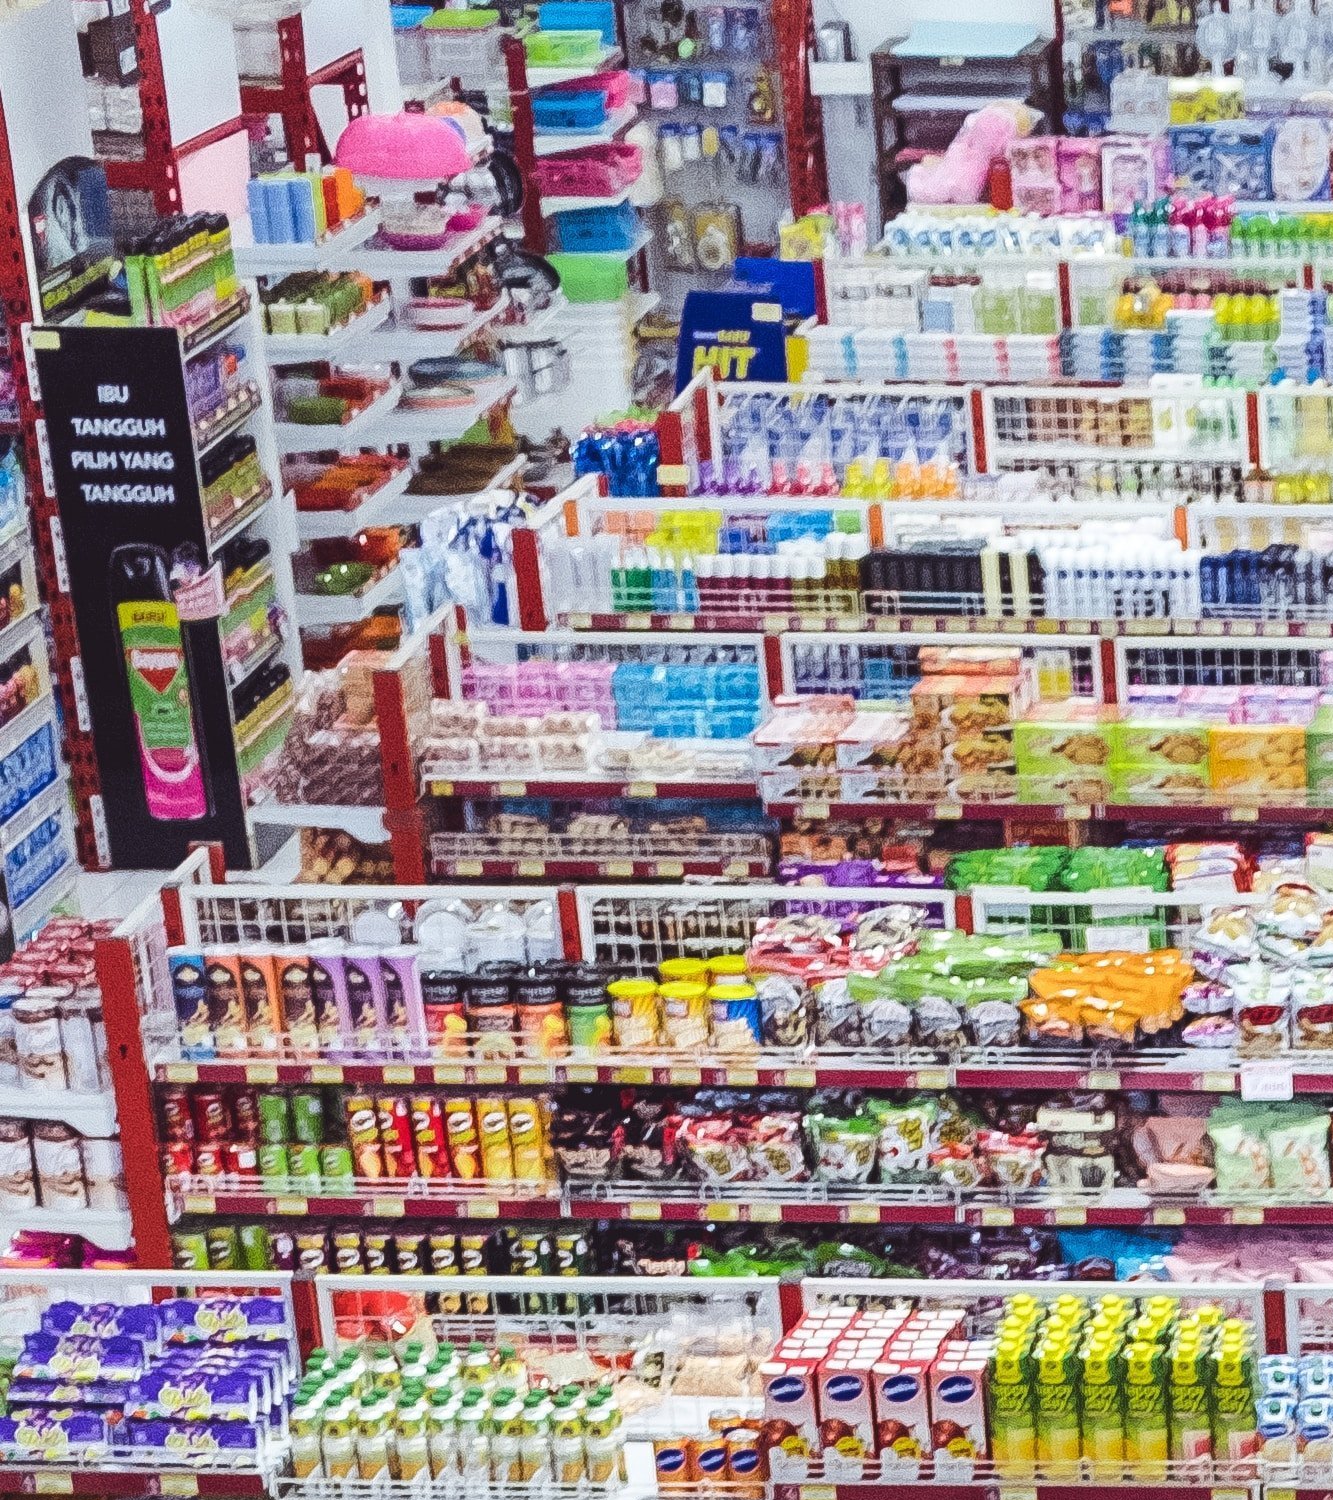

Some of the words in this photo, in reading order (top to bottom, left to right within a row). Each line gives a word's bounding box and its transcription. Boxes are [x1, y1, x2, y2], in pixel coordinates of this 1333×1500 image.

[98, 385, 129, 404] IBU
[71, 417, 166, 437] TANGGUH
[71, 452, 115, 470] PILIH
[117, 452, 174, 471] YANG
[80, 484, 175, 503] TANGGUH
